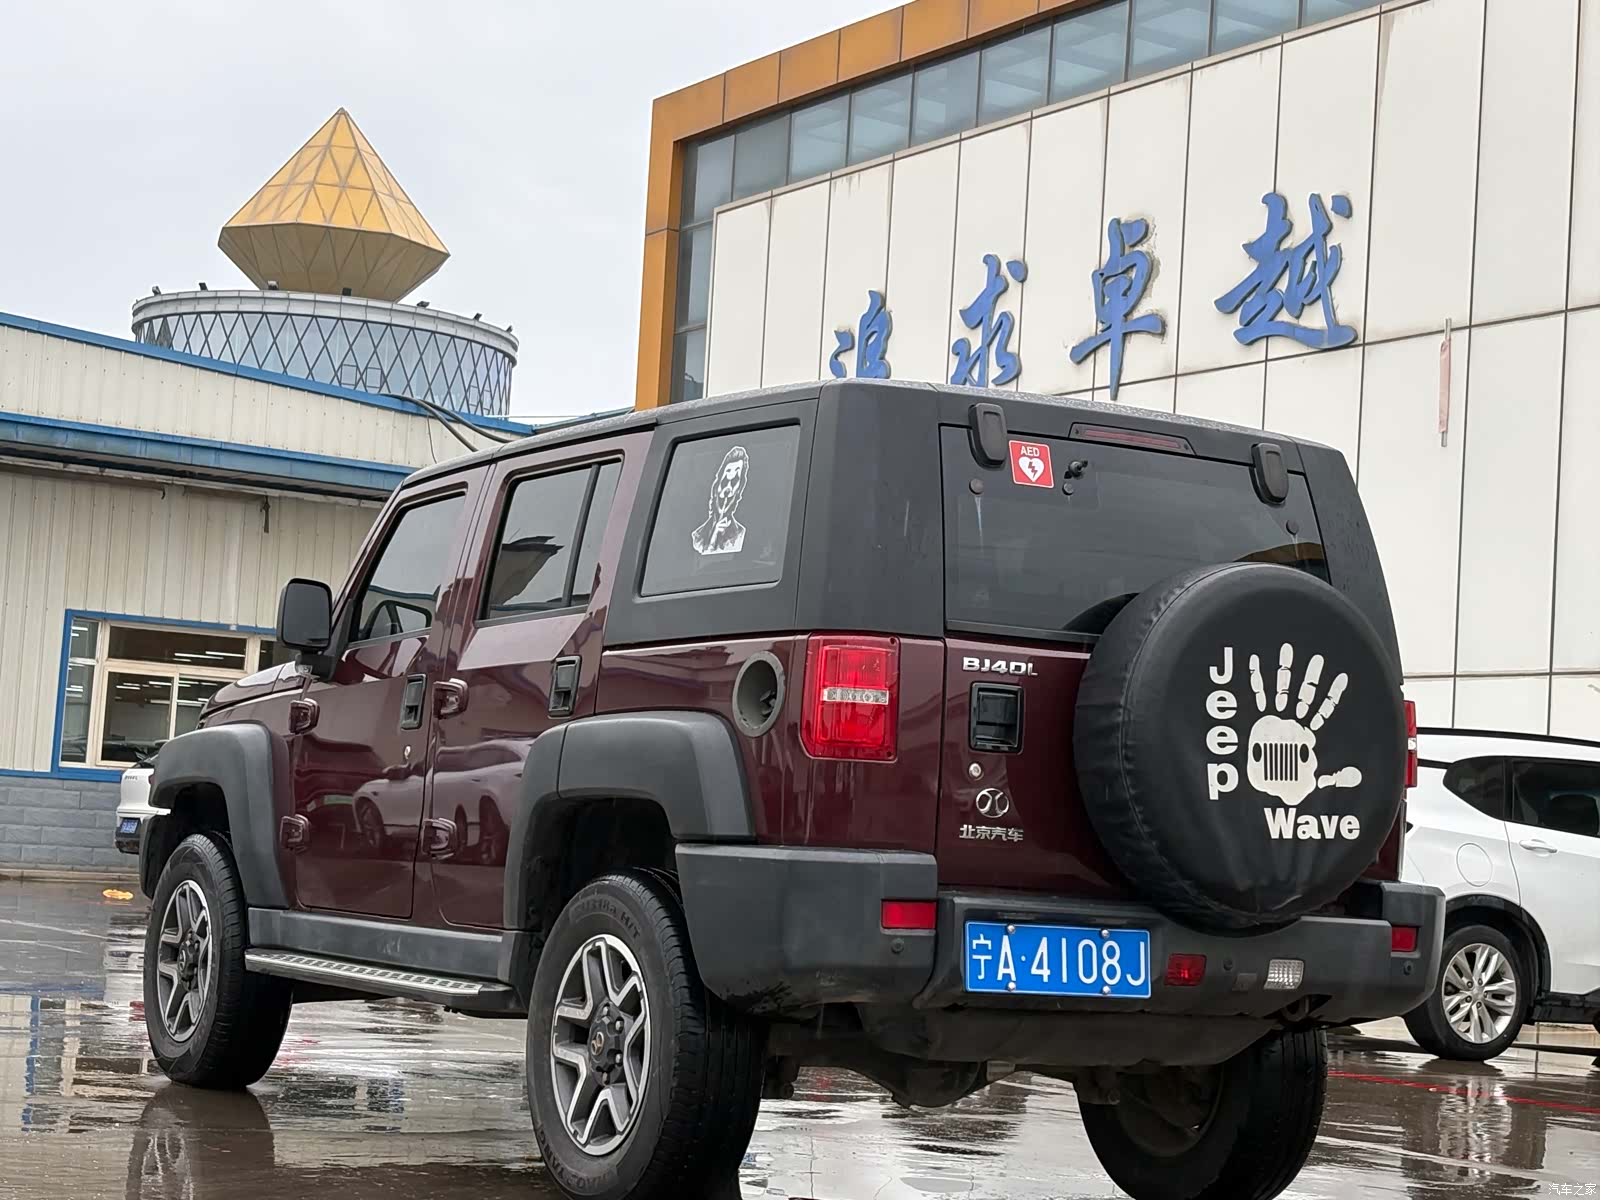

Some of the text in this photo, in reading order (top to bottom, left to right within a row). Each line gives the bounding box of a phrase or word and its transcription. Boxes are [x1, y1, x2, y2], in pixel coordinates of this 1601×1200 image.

[829, 192, 1358, 400] 追求卓越
[1020, 446, 1040, 457] AED
[1205, 646, 1240, 800] Jeep
[959, 824, 1025, 842] 北京汽车
[1263, 807, 1361, 840] Wave
